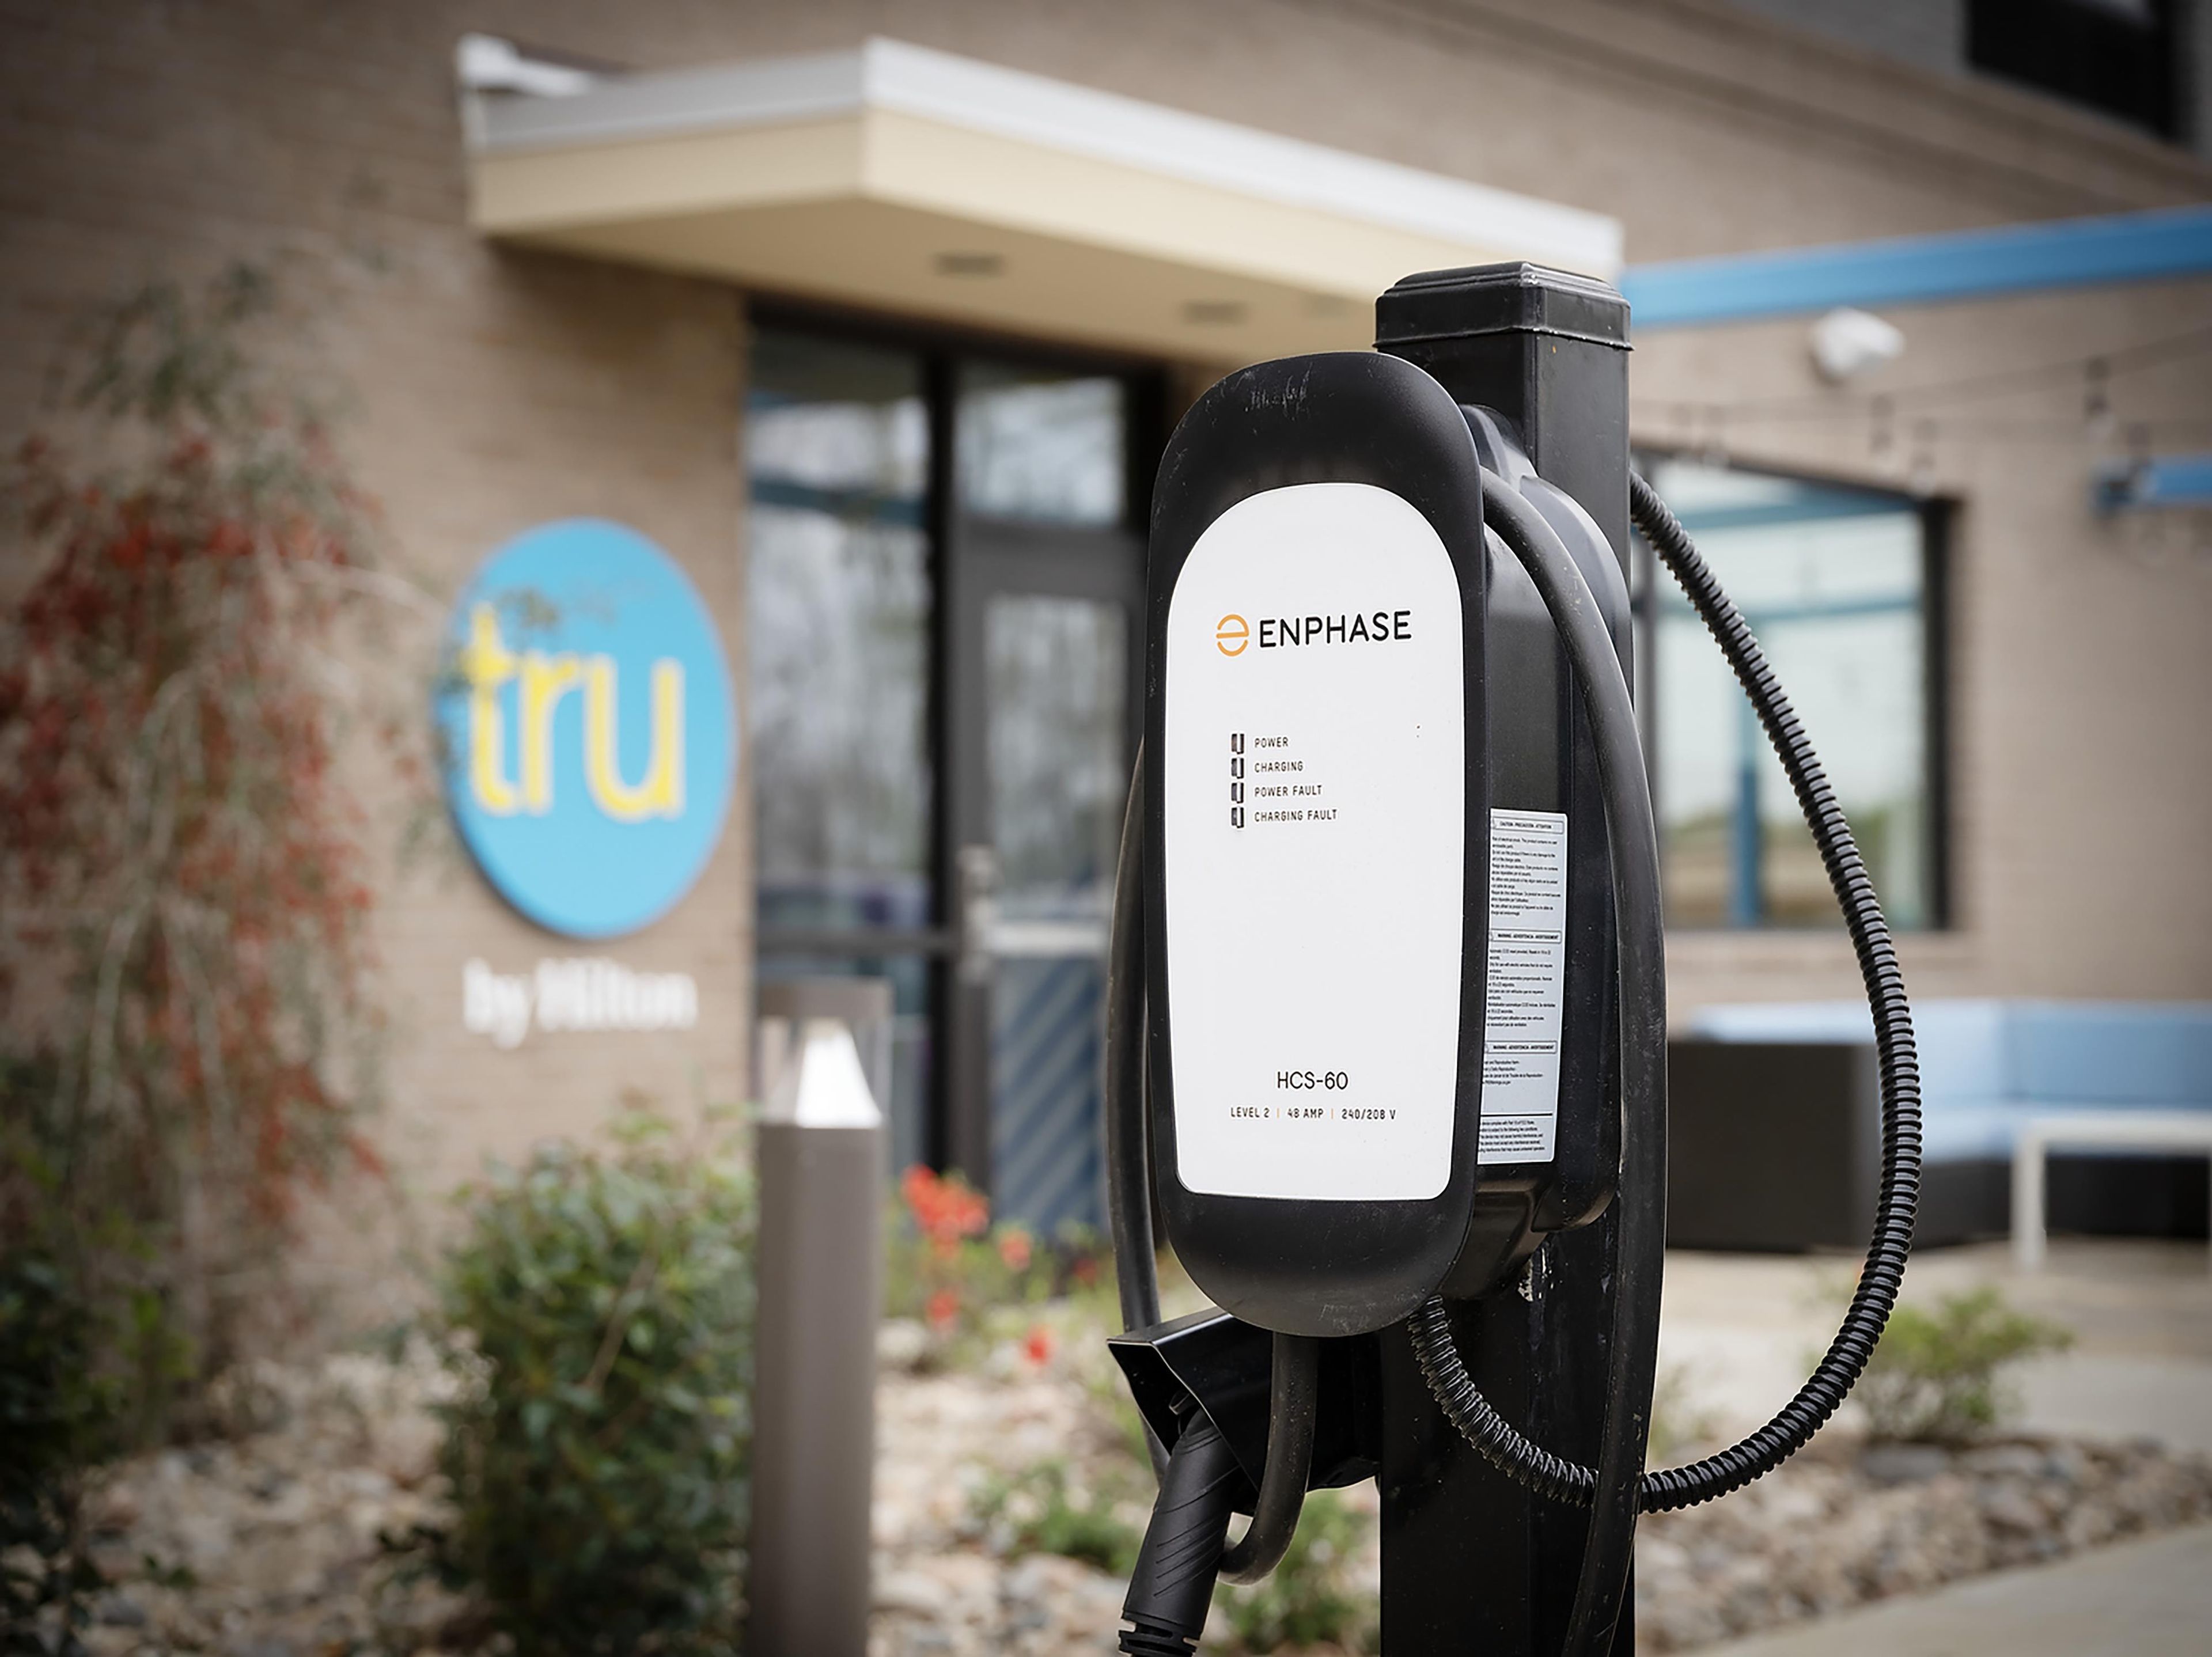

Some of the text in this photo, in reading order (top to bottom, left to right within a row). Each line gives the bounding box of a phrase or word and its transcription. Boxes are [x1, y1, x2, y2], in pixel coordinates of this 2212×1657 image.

[1260, 611, 1412, 647] ENPHASE
[459, 602, 685, 824] tru
[1255, 737, 1289, 748] POWER
[1254, 761, 1304, 773] CHARGING
[1255, 784, 1322, 797] POWER FAULT
[1254, 809, 1337, 822] CHARGING FAULT
[1277, 1071, 1349, 1090] HCS-60
[1230, 1107, 1396, 1120] LEVEL 2 48 AMP 240/208 V
